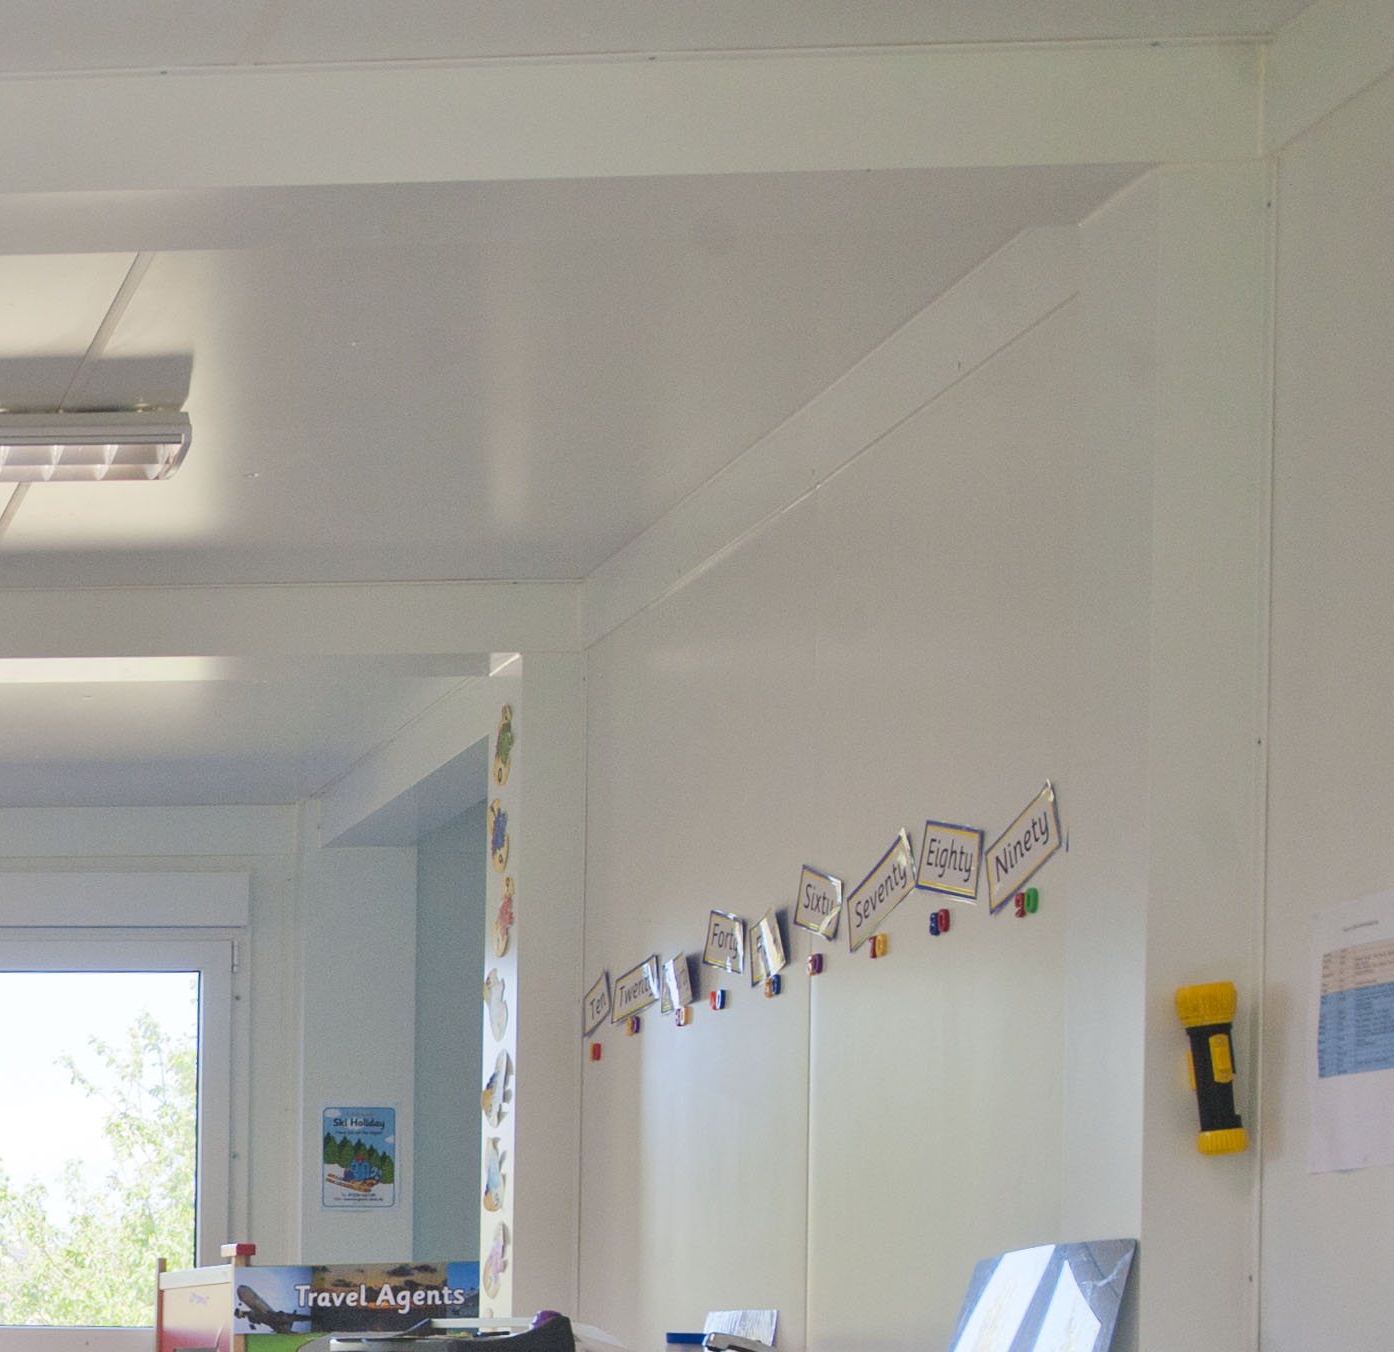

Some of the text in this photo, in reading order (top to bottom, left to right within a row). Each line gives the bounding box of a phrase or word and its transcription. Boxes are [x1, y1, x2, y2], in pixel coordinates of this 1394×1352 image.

[926, 838, 973, 882] Eighty
[995, 810, 1050, 882] Ninety
[855, 864, 907, 928] Seventy
[711, 923, 739, 960] Forty
[590, 993, 607, 1017] Ten
[332, 1117, 385, 1130] Ski Holiday
[294, 1283, 465, 1315] Travel Agents
